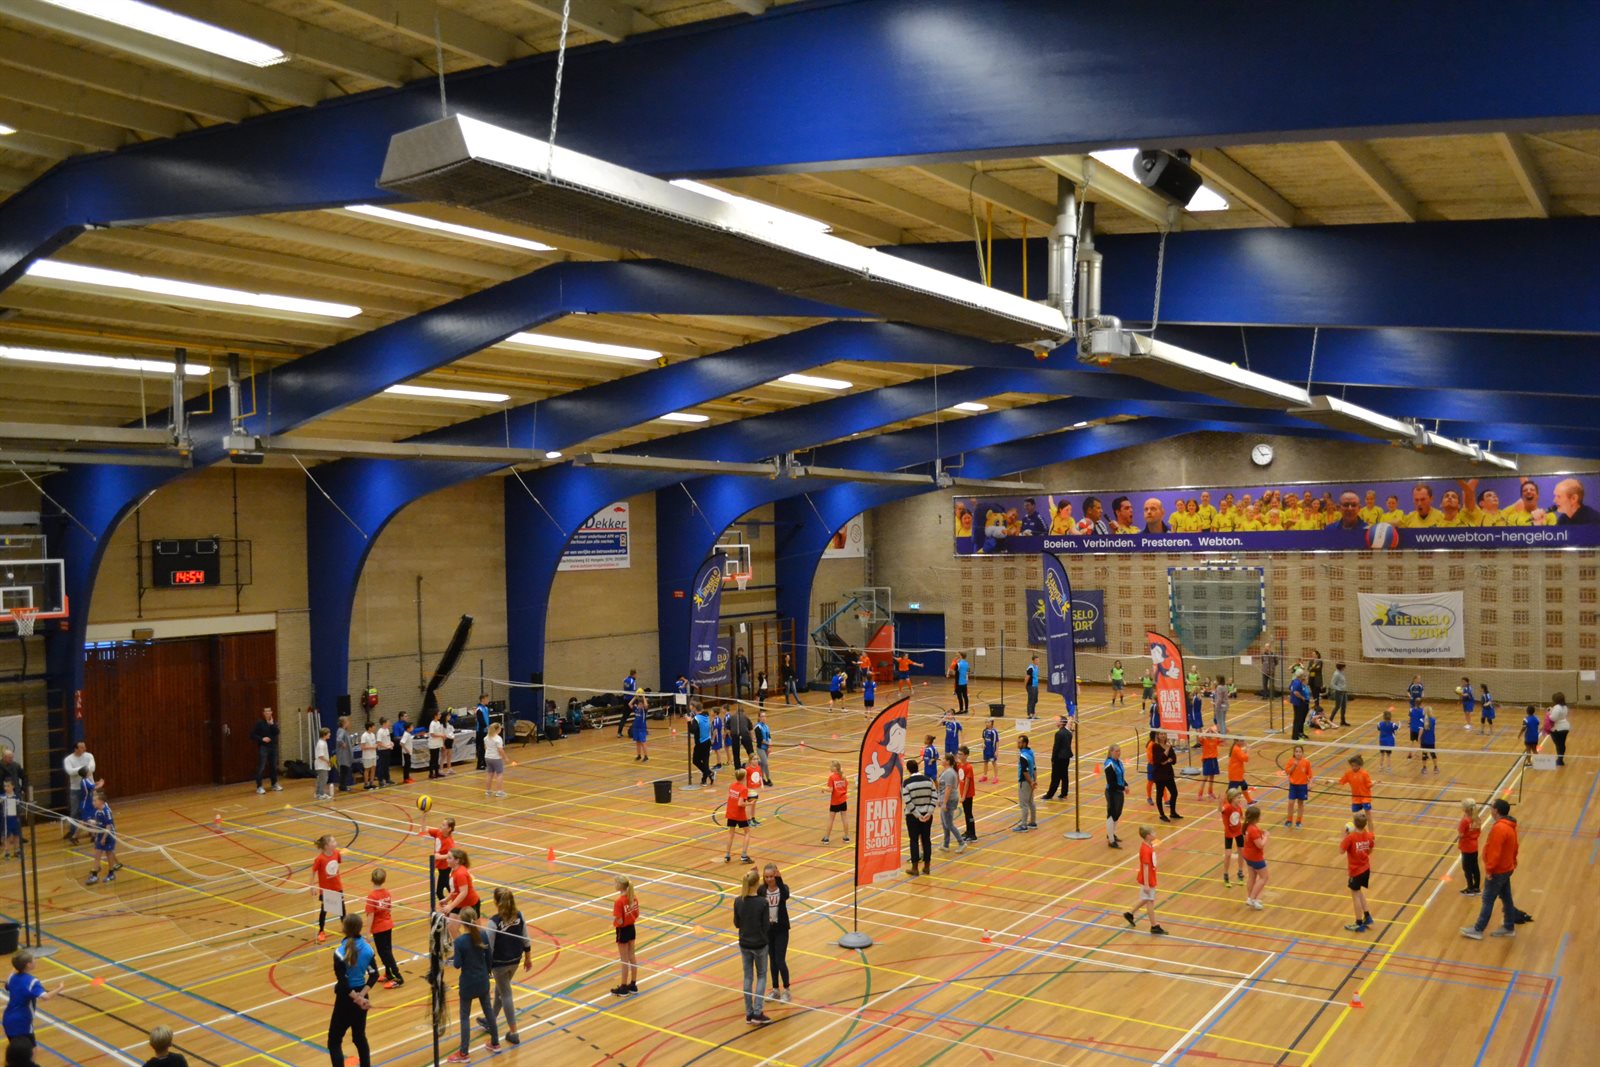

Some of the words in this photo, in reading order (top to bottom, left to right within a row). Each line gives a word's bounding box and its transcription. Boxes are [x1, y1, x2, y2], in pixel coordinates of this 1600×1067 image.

[585, 515, 626, 529] Dekker
[1043, 538, 1078, 549] Boeien.
[1083, 538, 1136, 549] Verbinden.
[1141, 537, 1192, 548] Presteren.
[1198, 535, 1243, 548] Webton.
[1415, 530, 1568, 544] www.webton-hengelo.nl
[175, 571, 205, 584] 14:54
[1395, 614, 1451, 626] HENGELO
[1409, 627, 1449, 639] SPORT
[1375, 646, 1451, 654] www.hengelosport.nl
[866, 799, 898, 820] FAIR
[865, 819, 895, 839] PLAY
